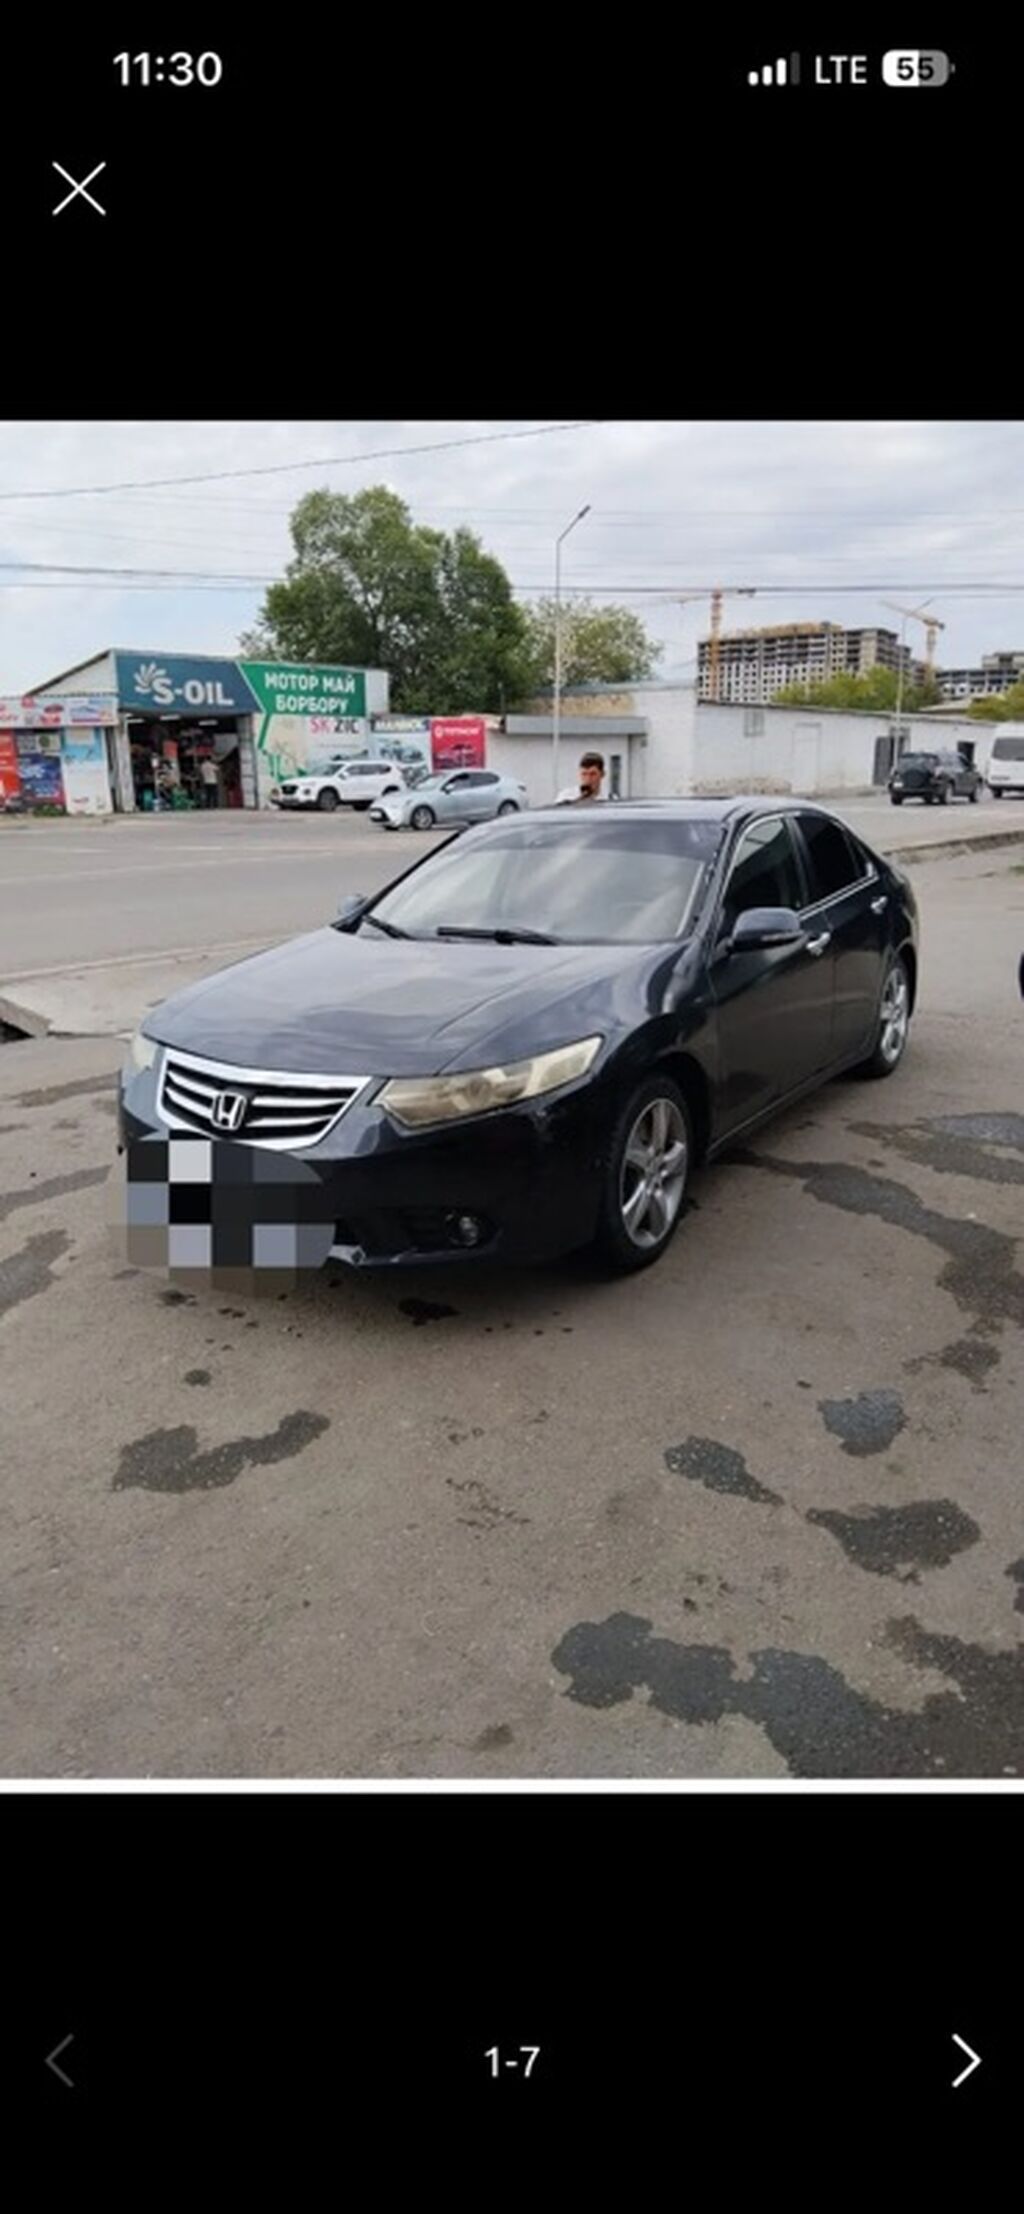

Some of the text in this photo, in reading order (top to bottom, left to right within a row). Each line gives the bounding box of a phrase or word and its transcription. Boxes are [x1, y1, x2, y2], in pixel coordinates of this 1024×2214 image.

[152, 677, 234, 706] S-OIL
[264, 671, 356, 694] МОТОР МАЙ
[275, 694, 349, 714] БОРБОРУ
